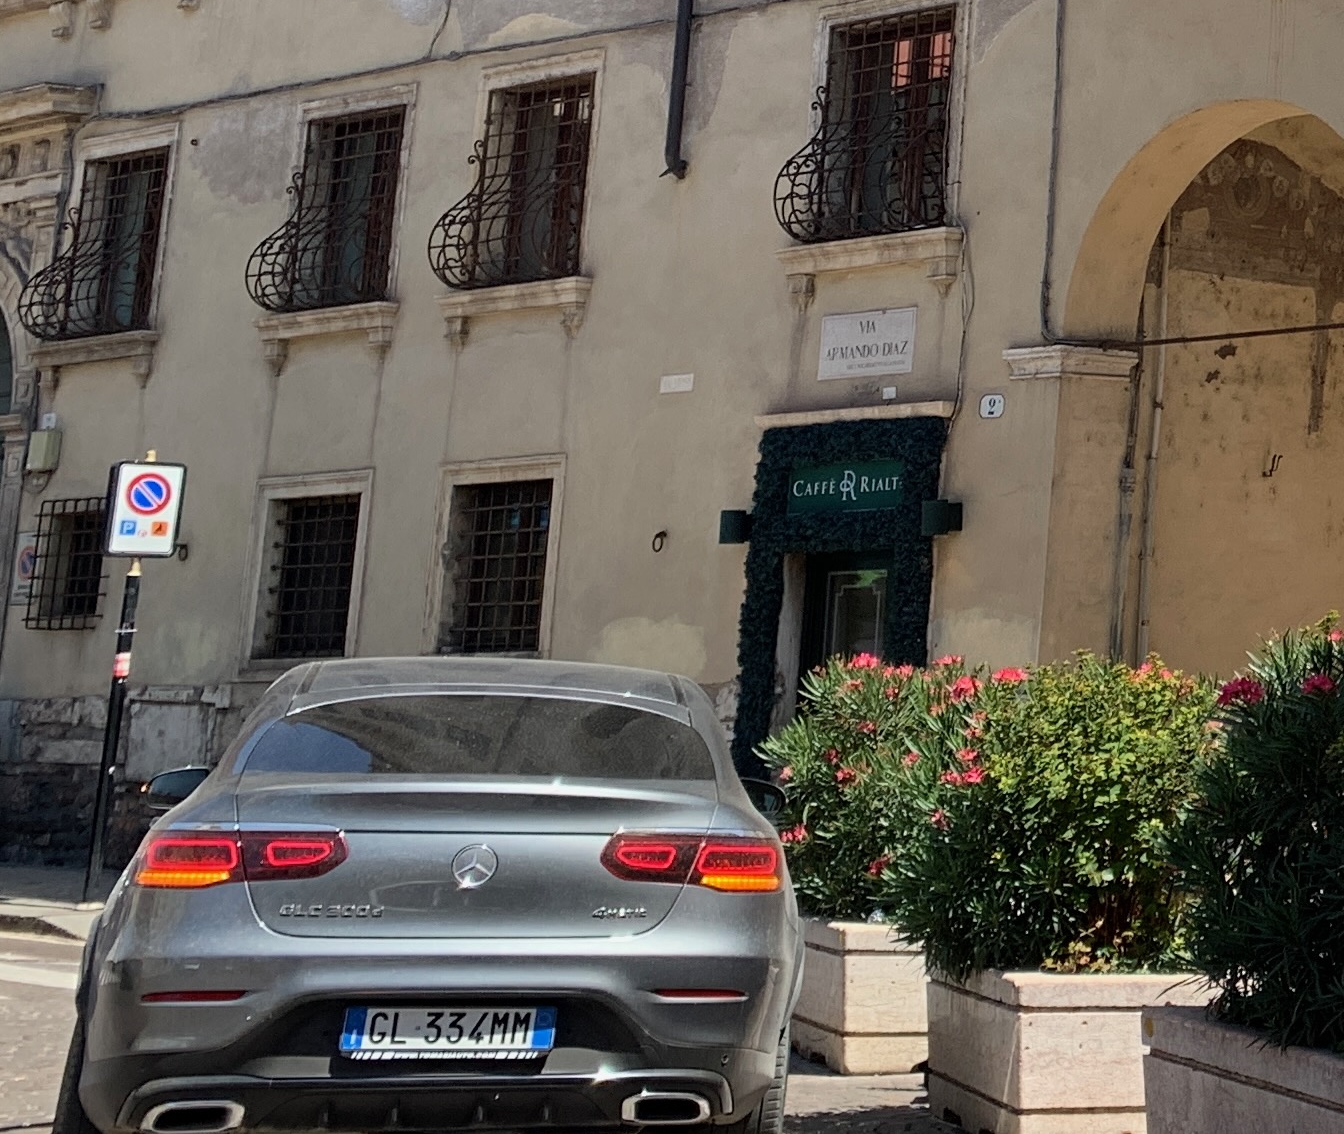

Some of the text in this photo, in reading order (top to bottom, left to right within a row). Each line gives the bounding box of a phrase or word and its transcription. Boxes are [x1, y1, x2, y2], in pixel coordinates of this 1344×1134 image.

[860, 320, 876, 334] VIA
[826, 341, 908, 361] ARMANDO DIAZ
[369, 1012, 532, 1045] GL 334MM
